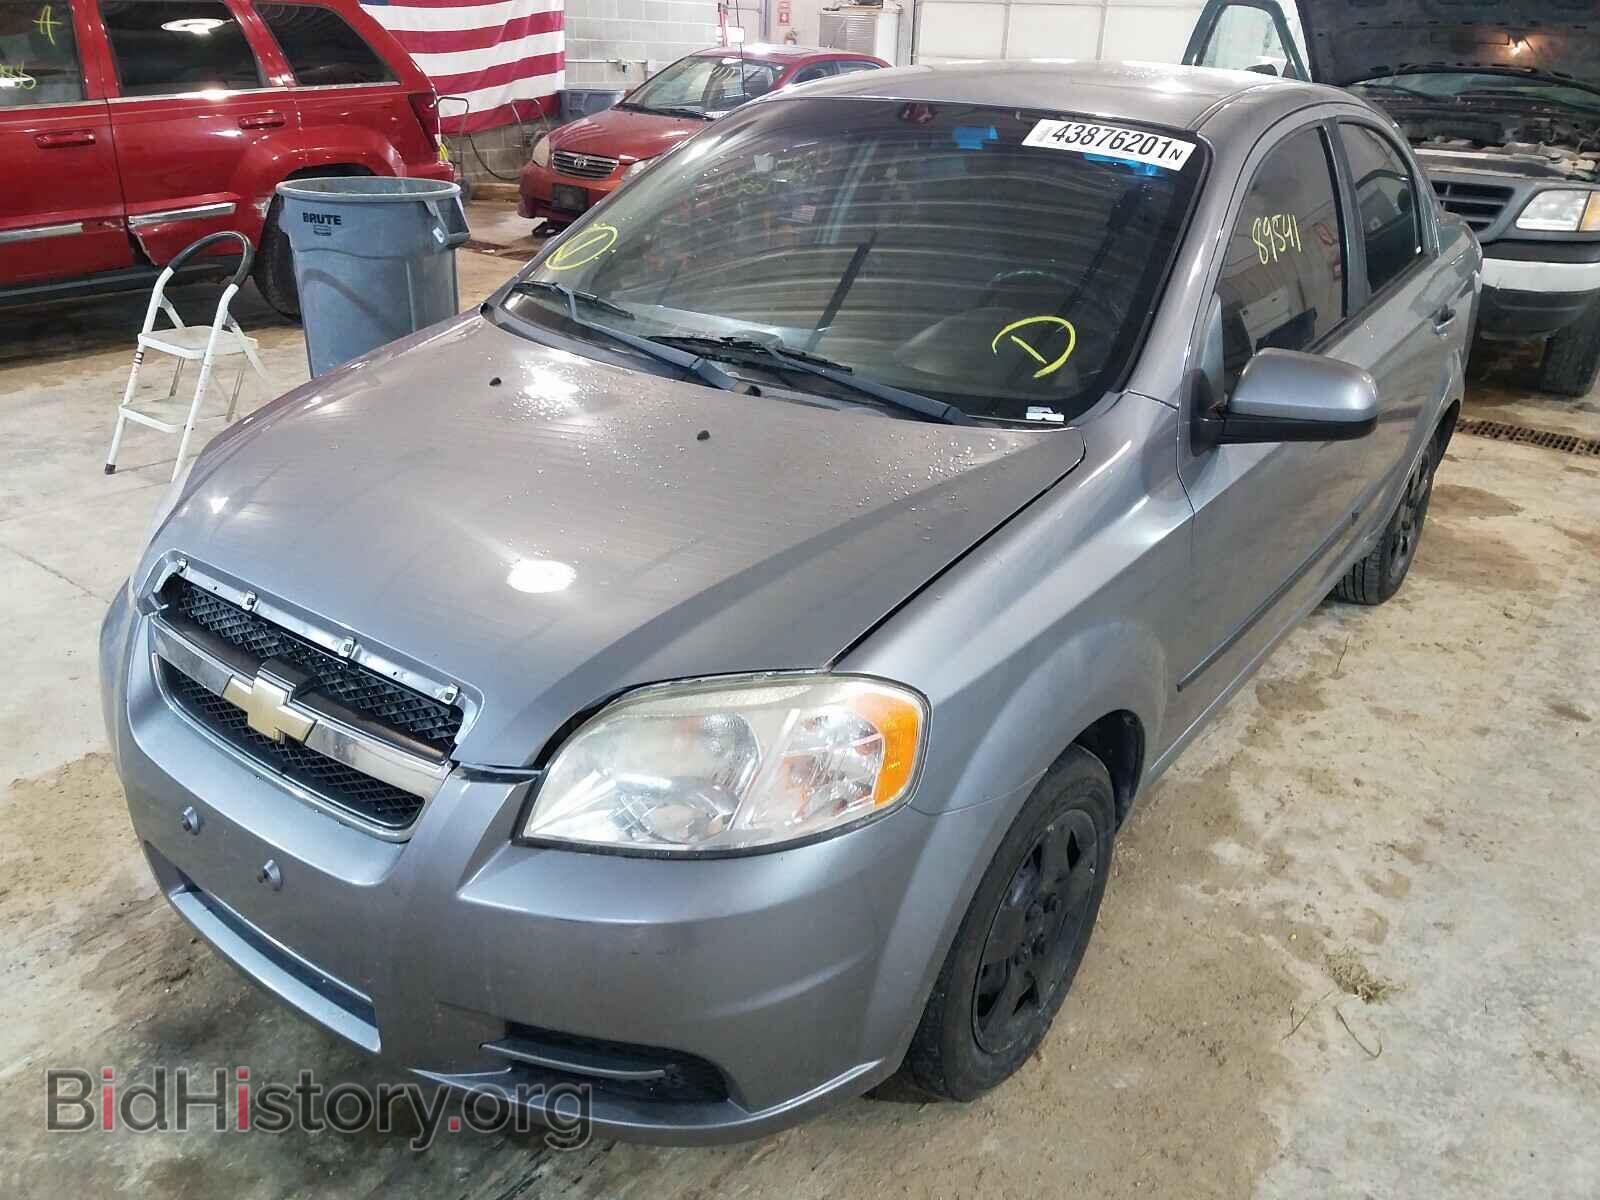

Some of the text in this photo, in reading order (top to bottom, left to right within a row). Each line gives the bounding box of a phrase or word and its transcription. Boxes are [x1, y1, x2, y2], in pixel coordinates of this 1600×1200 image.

[1052, 123, 1173, 159] 43876201
[1168, 148, 1184, 161] N
[302, 211, 342, 226] BRUTE
[1252, 213, 1302, 265] 89541
